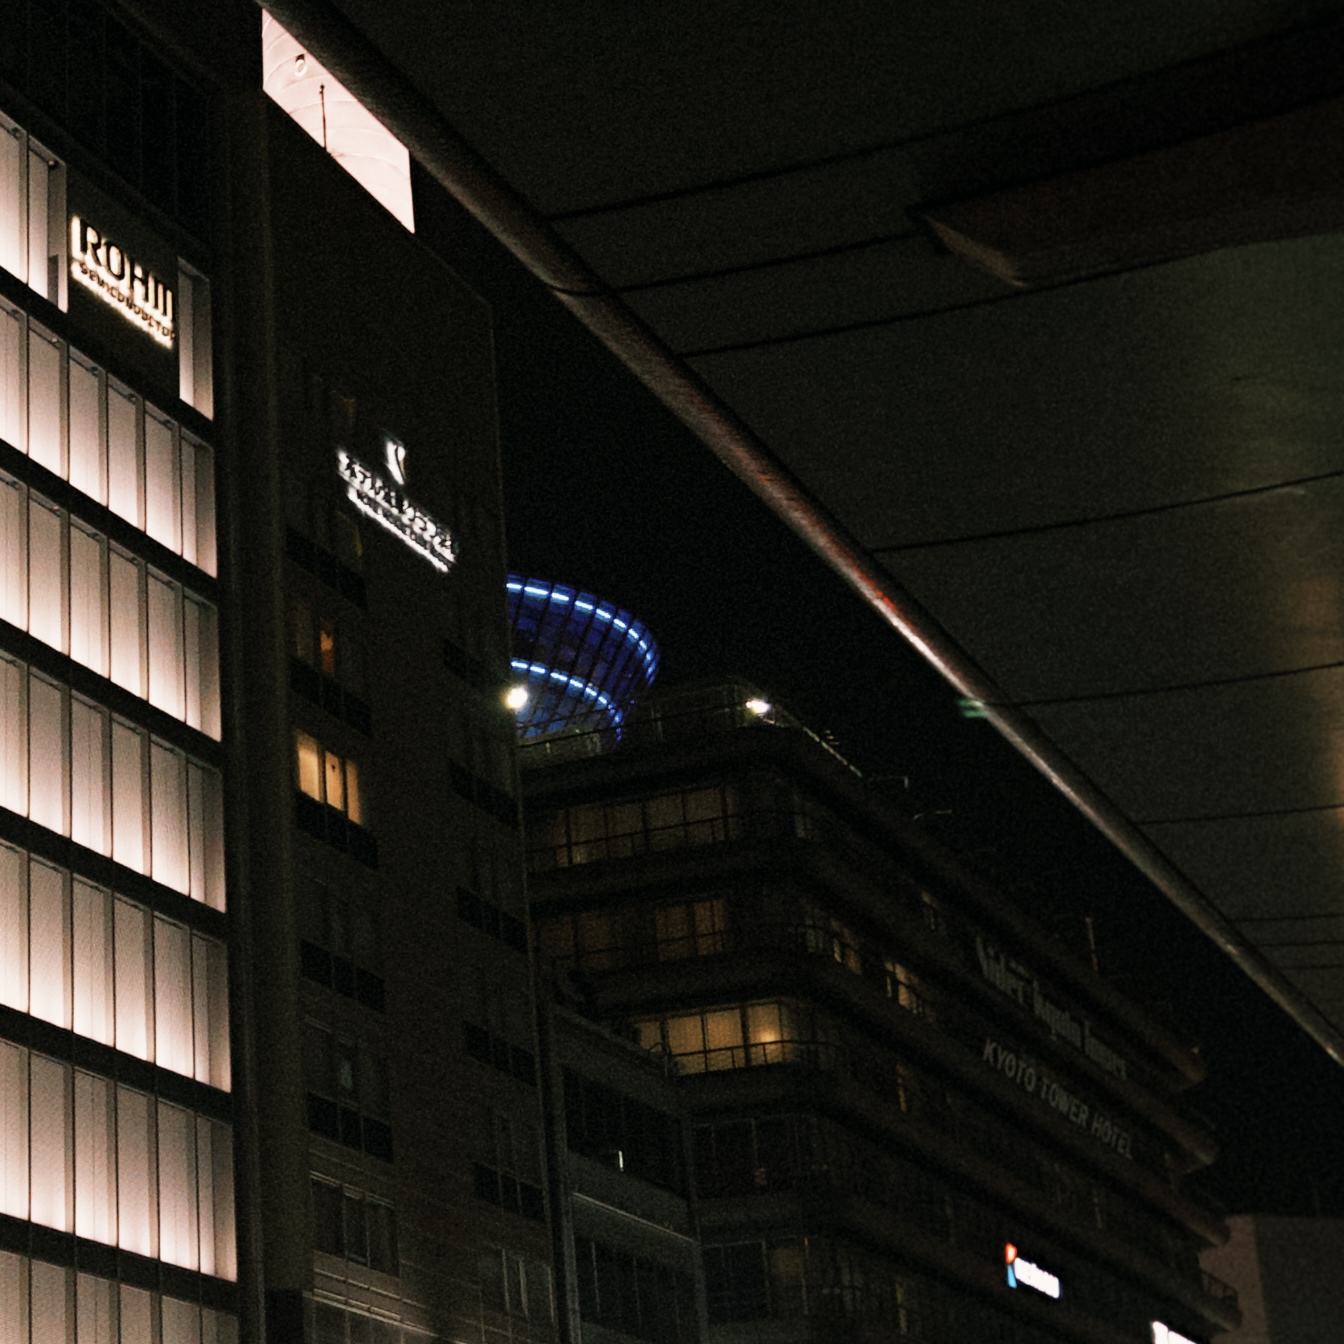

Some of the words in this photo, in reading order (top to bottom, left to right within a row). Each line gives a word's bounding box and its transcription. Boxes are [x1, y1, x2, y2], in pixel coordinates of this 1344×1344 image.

[76, 260, 176, 343] SEMICONDUCTOR
[982, 1036, 1037, 1093] KYOTO
[1040, 1076, 1090, 1129] TOWER
[1091, 1111, 1134, 1160] HOTEL
